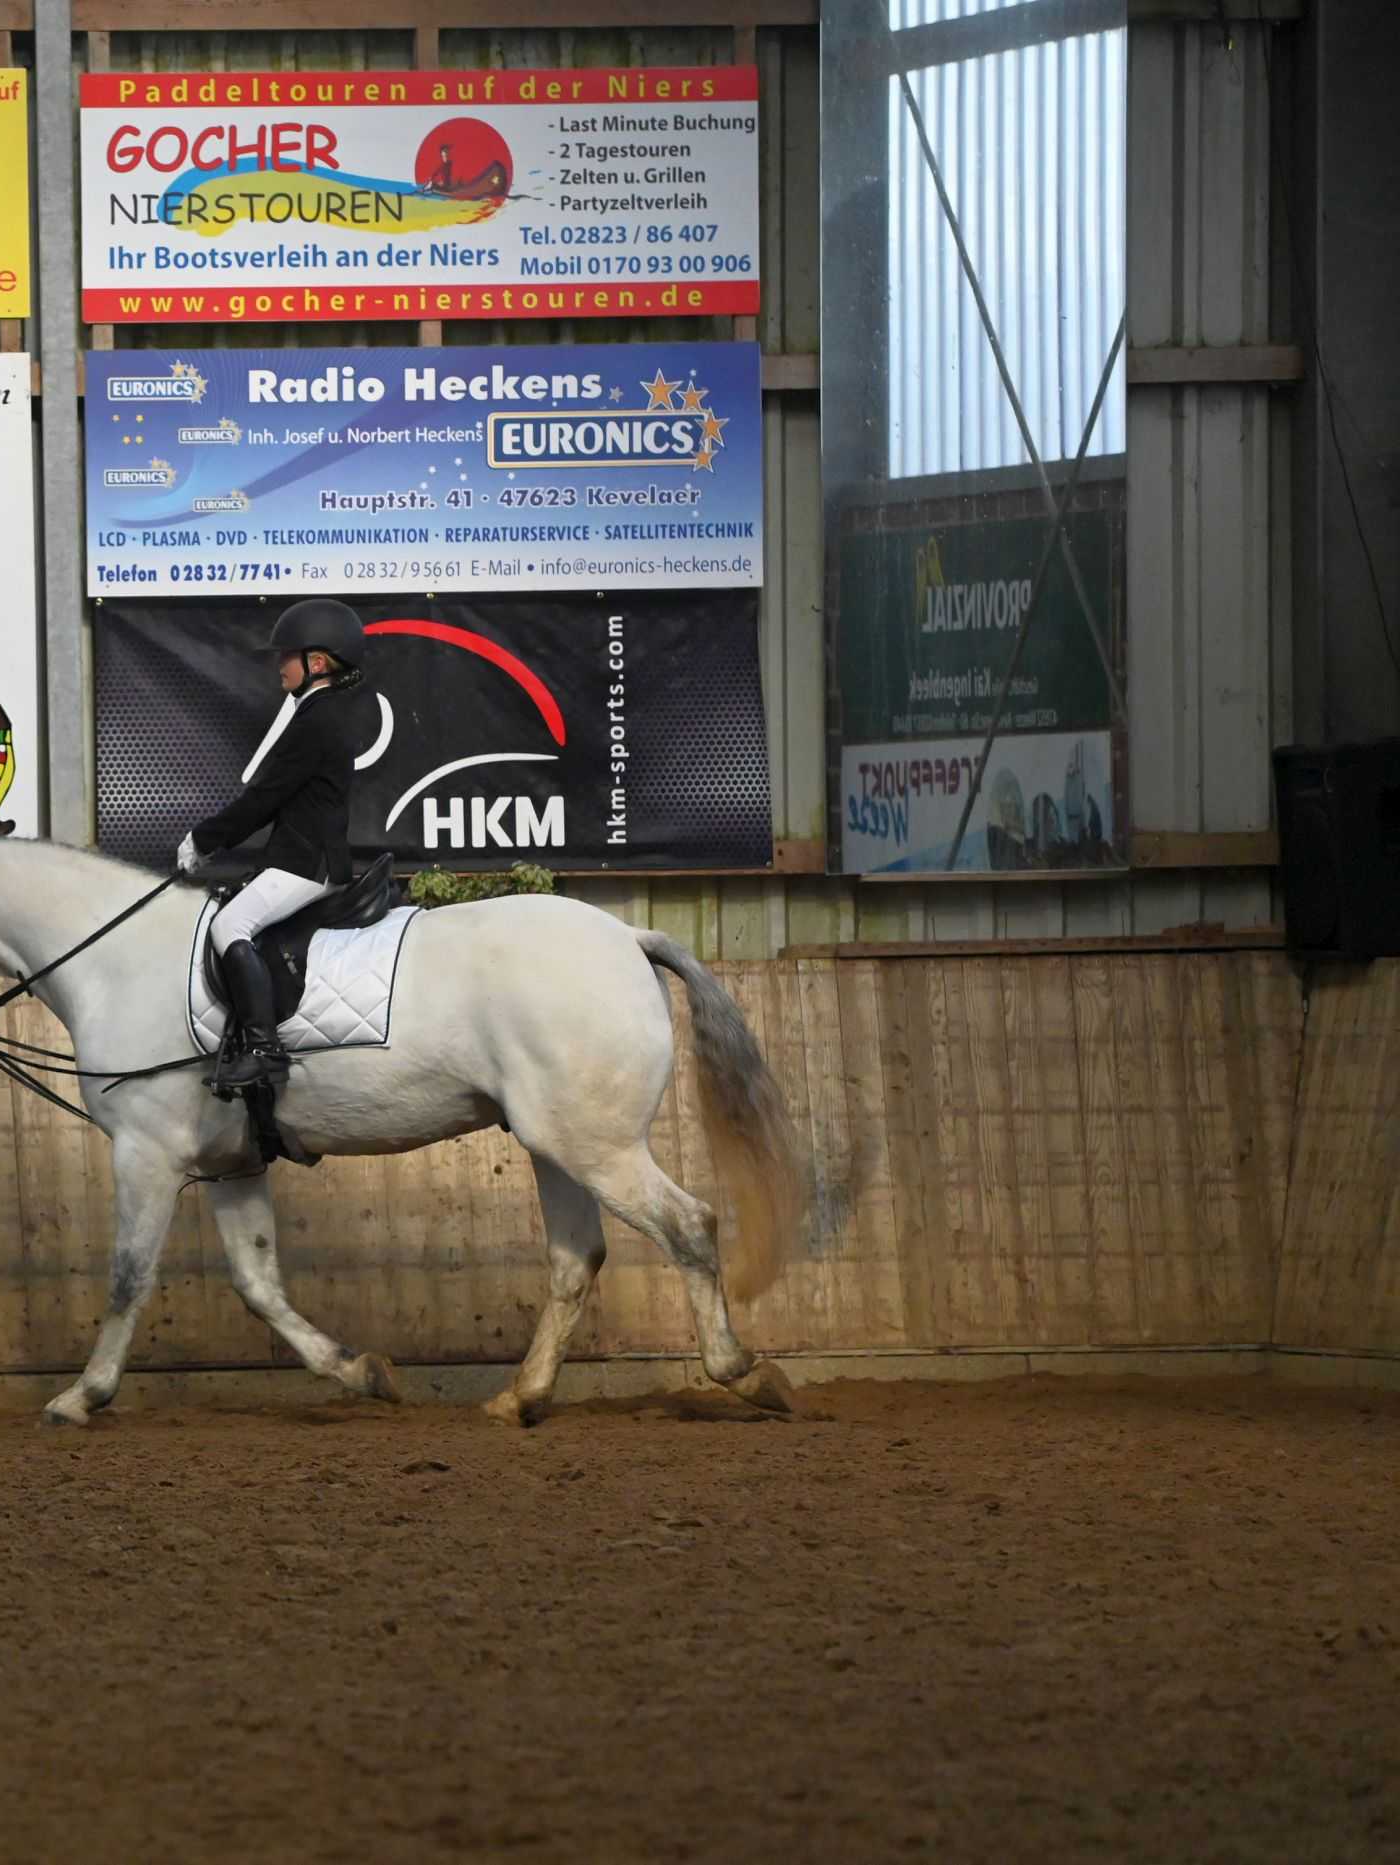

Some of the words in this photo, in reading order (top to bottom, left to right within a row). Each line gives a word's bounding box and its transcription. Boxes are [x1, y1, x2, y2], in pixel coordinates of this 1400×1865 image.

[120, 79, 407, 104] Paddeltouren
[433, 76, 496, 101] auf
[519, 76, 584, 100] der
[609, 75, 715, 99] Niers
[560, 117, 596, 132] Last
[603, 116, 667, 131] Minute
[674, 114, 755, 133] Buchung
[106, 123, 339, 173] GOCHER
[560, 144, 570, 158] 2
[575, 142, 691, 163] Tagestouren
[560, 169, 618, 184] Zelten
[624, 173, 639, 184] u.
[644, 168, 705, 184] Grillen
[110, 190, 402, 225] NIERSTOUREN
[560, 193, 707, 214] Partyzeltverleih
[520, 226, 556, 245] Tel.
[561, 226, 627, 244] 02823
[646, 225, 672, 243] 86
[679, 224, 718, 242] 407
[109, 248, 145, 270] Ihr
[154, 245, 327, 270] Bootsverleih
[335, 250, 370, 268] an
[377, 245, 423, 268] der
[430, 243, 499, 267] Niers
[520, 256, 581, 276] Mobil
[588, 256, 640, 275] 0170
[647, 256, 673, 274] 93
[679, 255, 705, 274] 00
[712, 254, 751, 273] 906
[120, 287, 703, 317] www.gocher-nierstouren.de
[112, 381, 193, 396] EURONICS
[248, 366, 385, 403] Radio
[404, 365, 602, 401] Heckens
[181, 430, 233, 441] EURONICS
[248, 428, 278, 445] Inh.
[284, 427, 322, 446] Josef
[327, 432, 343, 444] u.
[347, 427, 410, 444] Norbert
[415, 426, 483, 442] Heckens
[501, 420, 694, 457] EURONICS
[108, 472, 166, 483] EURONICS
[196, 500, 242, 510] EURONICS
[320, 489, 436, 513] Hauptstr.
[447, 488, 473, 508] 41
[500, 488, 577, 508] 47623
[587, 486, 700, 507] Kevelaer
[99, 532, 125, 547] LCD
[142, 530, 200, 547] PLASMA
[216, 530, 247, 546] DVD
[263, 528, 429, 545] TELEKOMMUNIKATION
[445, 525, 590, 543] REPARATURSERVICE
[604, 522, 754, 540] SATELLITENTECHNIK
[97, 565, 157, 583] Telefon
[302, 562, 328, 579] Fax
[471, 559, 520, 577] E-Mail
[541, 555, 751, 577] info@euronics-heckens.de
[607, 615, 630, 845] hkm-sports.com
[423, 796, 565, 850] HKM
